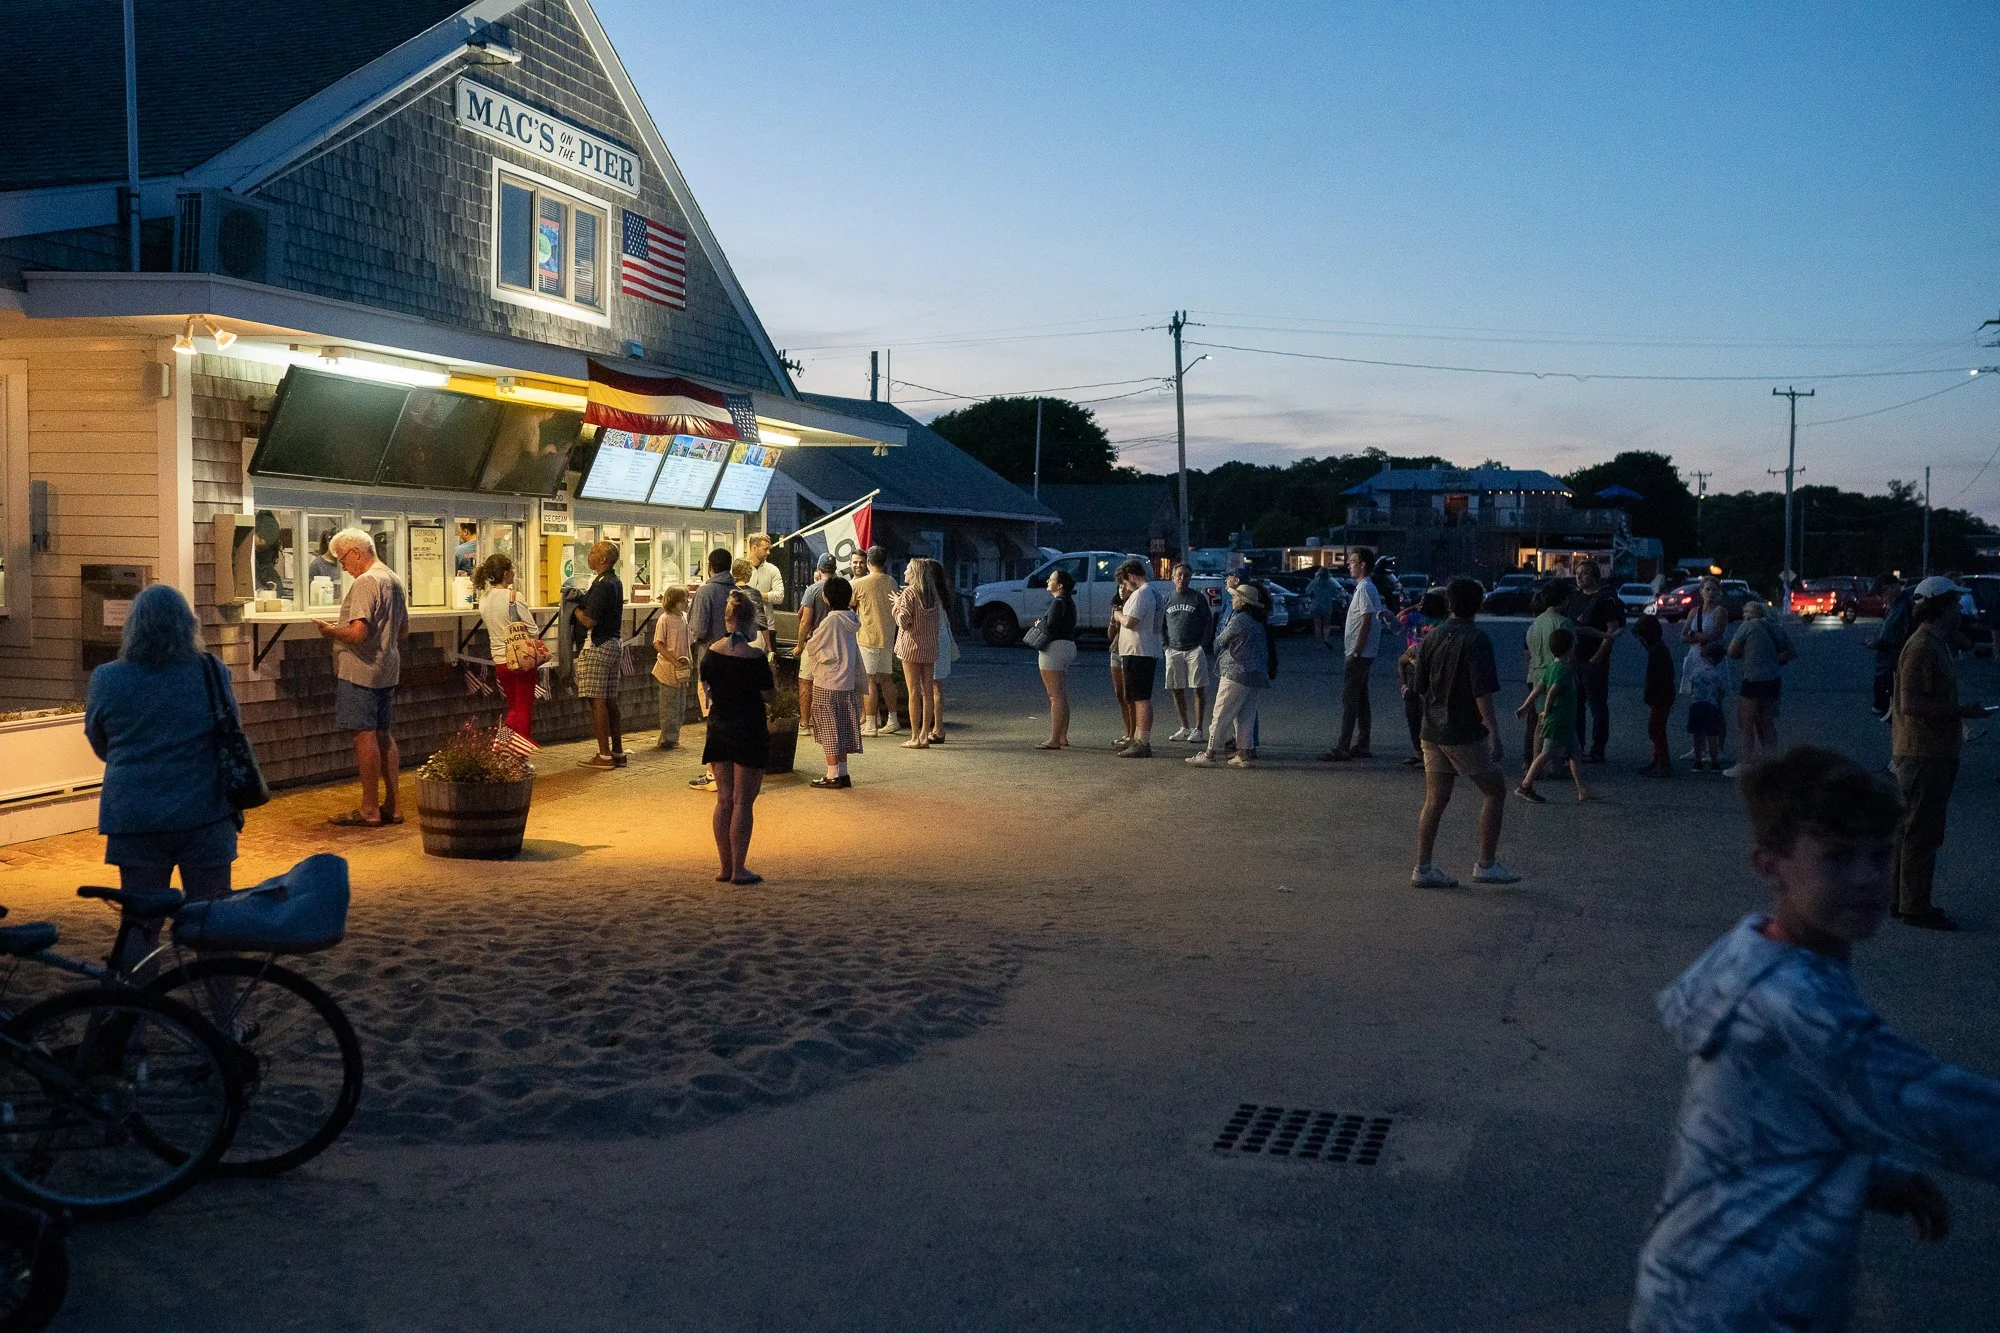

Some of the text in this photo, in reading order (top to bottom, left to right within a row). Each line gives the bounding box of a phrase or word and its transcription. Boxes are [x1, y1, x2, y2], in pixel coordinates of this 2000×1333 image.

[466, 88, 555, 153] MAC'S
[560, 130, 574, 145] ON
[558, 145, 576, 162] THE
[578, 138, 635, 187] PIER
[544, 514, 568, 523] ICE CREAM
[1166, 603, 1196, 614] WELLFLEET
